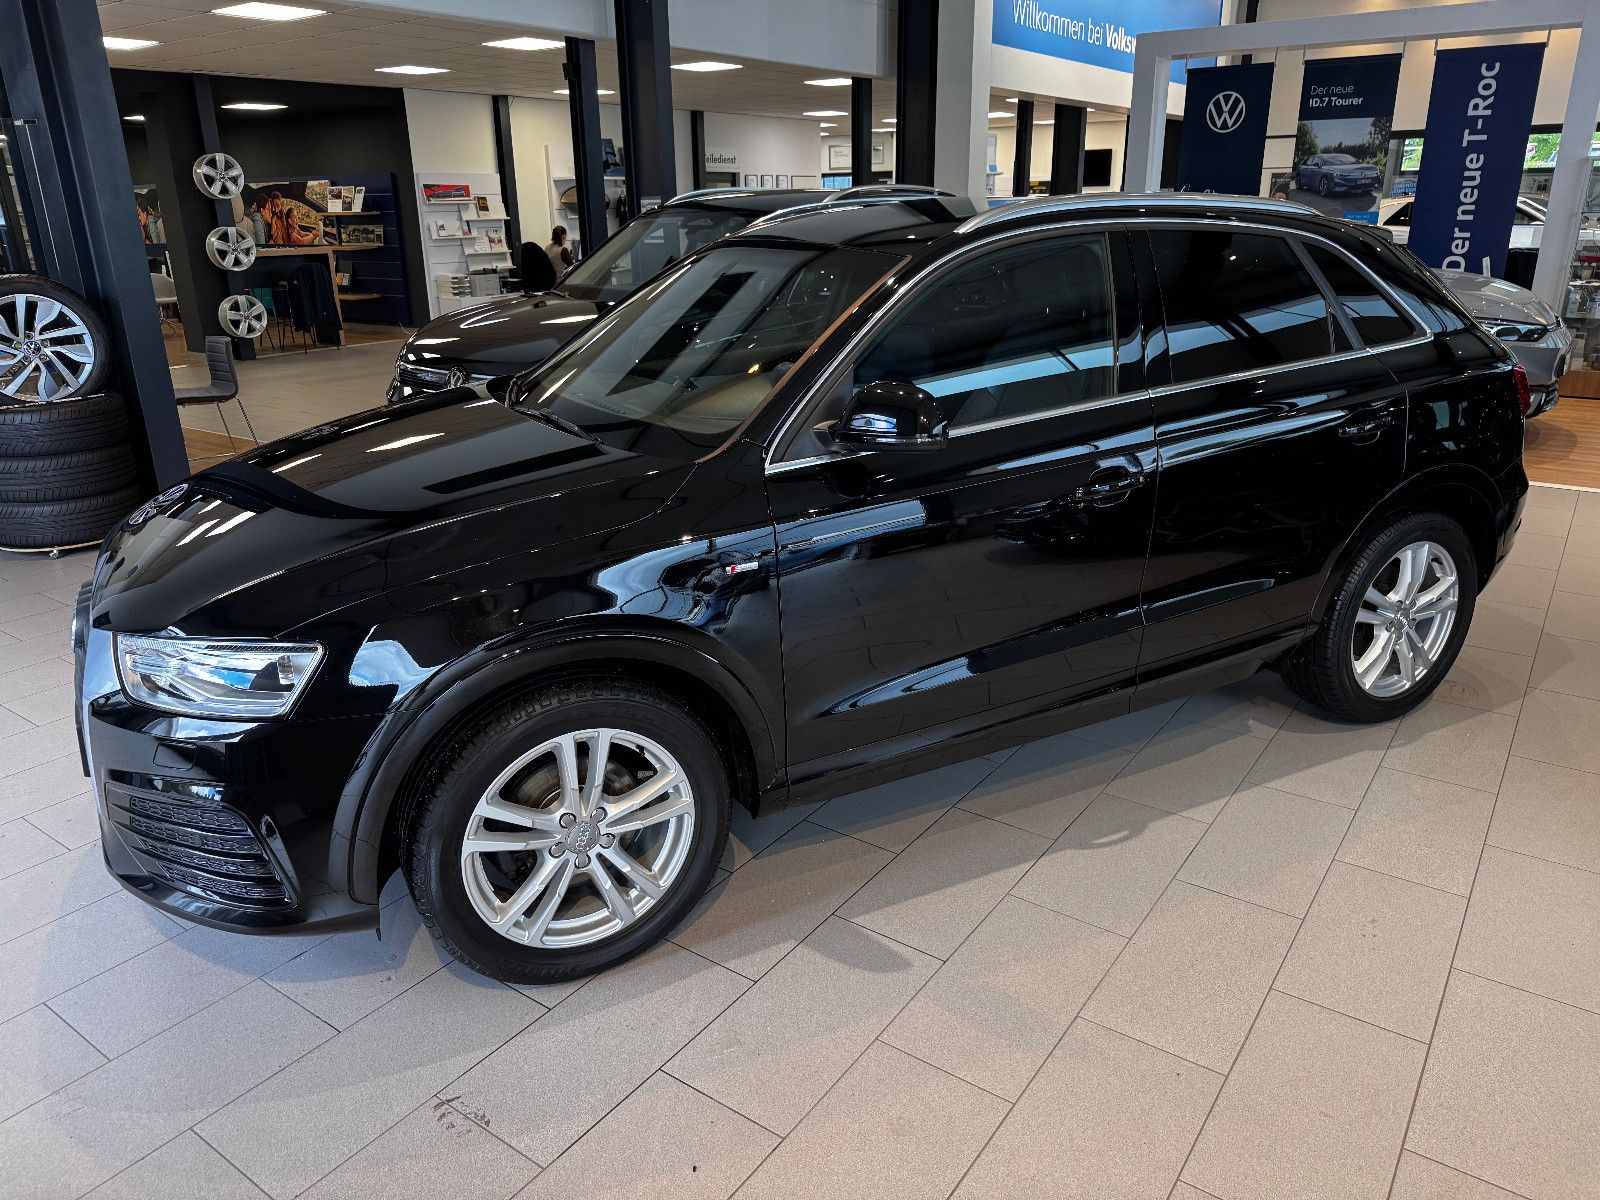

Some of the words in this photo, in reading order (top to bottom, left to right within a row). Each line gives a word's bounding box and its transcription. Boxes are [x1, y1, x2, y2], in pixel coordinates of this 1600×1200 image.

[1012, 0, 1085, 41] Willkommen
[1087, 18, 1104, 46] bei
[1309, 97, 1329, 107] ID.7
[1330, 96, 1364, 106] Tourer
[1311, 85, 1328, 95] Der
[1329, 85, 1355, 94] neue
[1462, 61, 1500, 147] T-Roc
[704, 153, 736, 164] eiledienst
[1456, 153, 1485, 221] neue
[1442, 227, 1471, 272] Der
